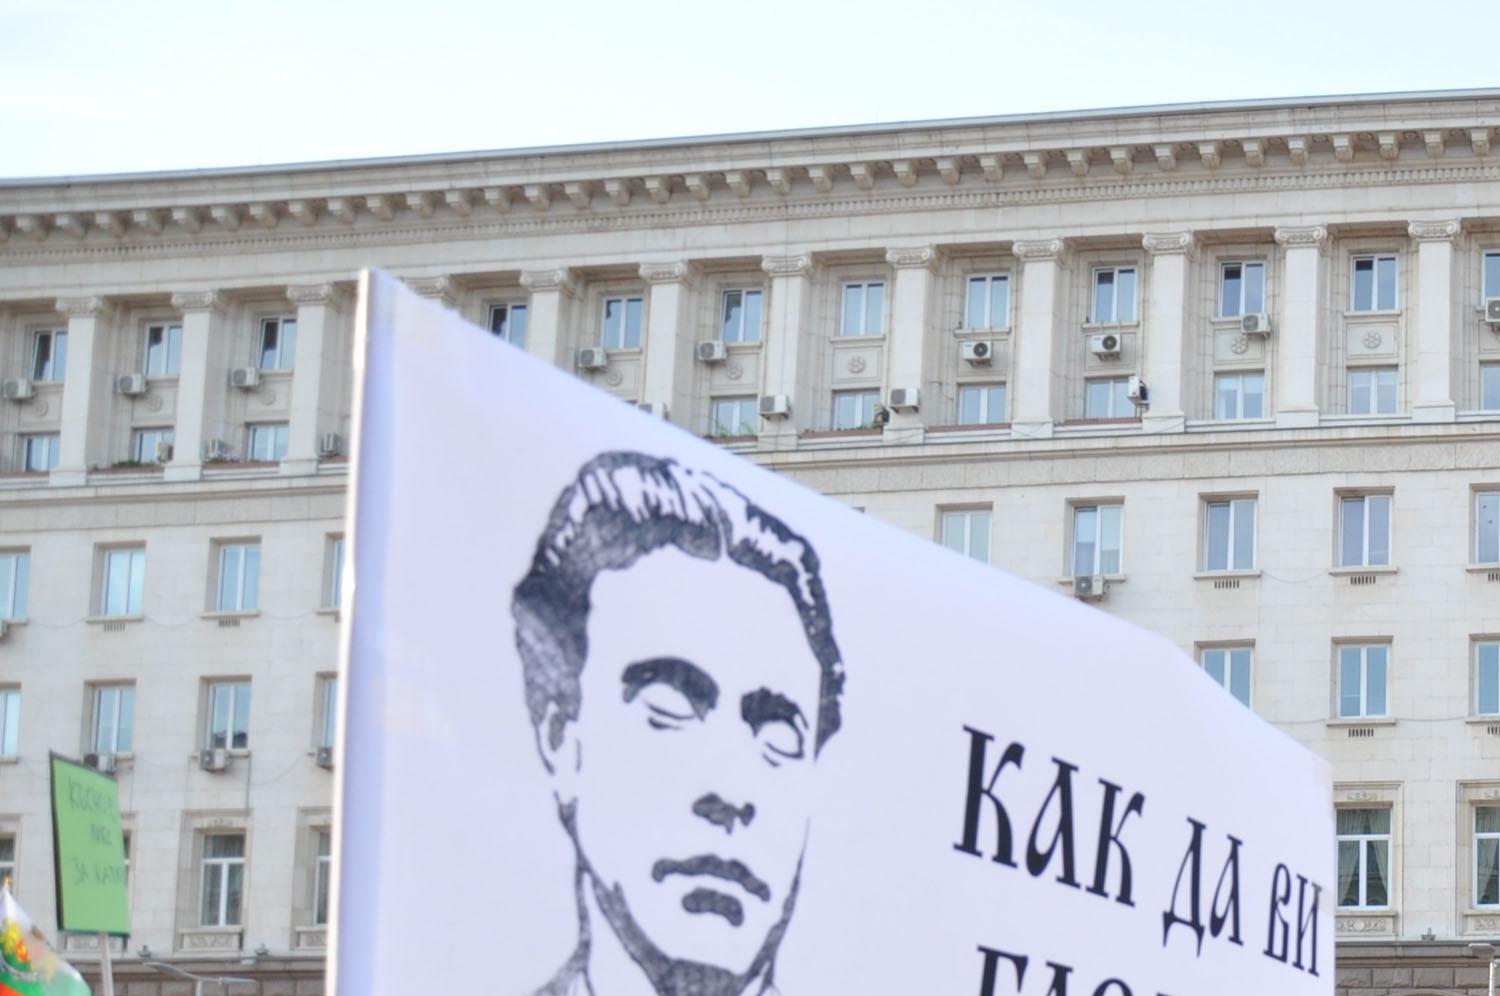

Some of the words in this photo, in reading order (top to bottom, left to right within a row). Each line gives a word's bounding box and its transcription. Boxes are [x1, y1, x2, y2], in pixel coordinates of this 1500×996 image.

[953, 724, 1146, 908] КАК
[1162, 816, 1244, 958] ДА
[1263, 862, 1323, 978] ВИ
